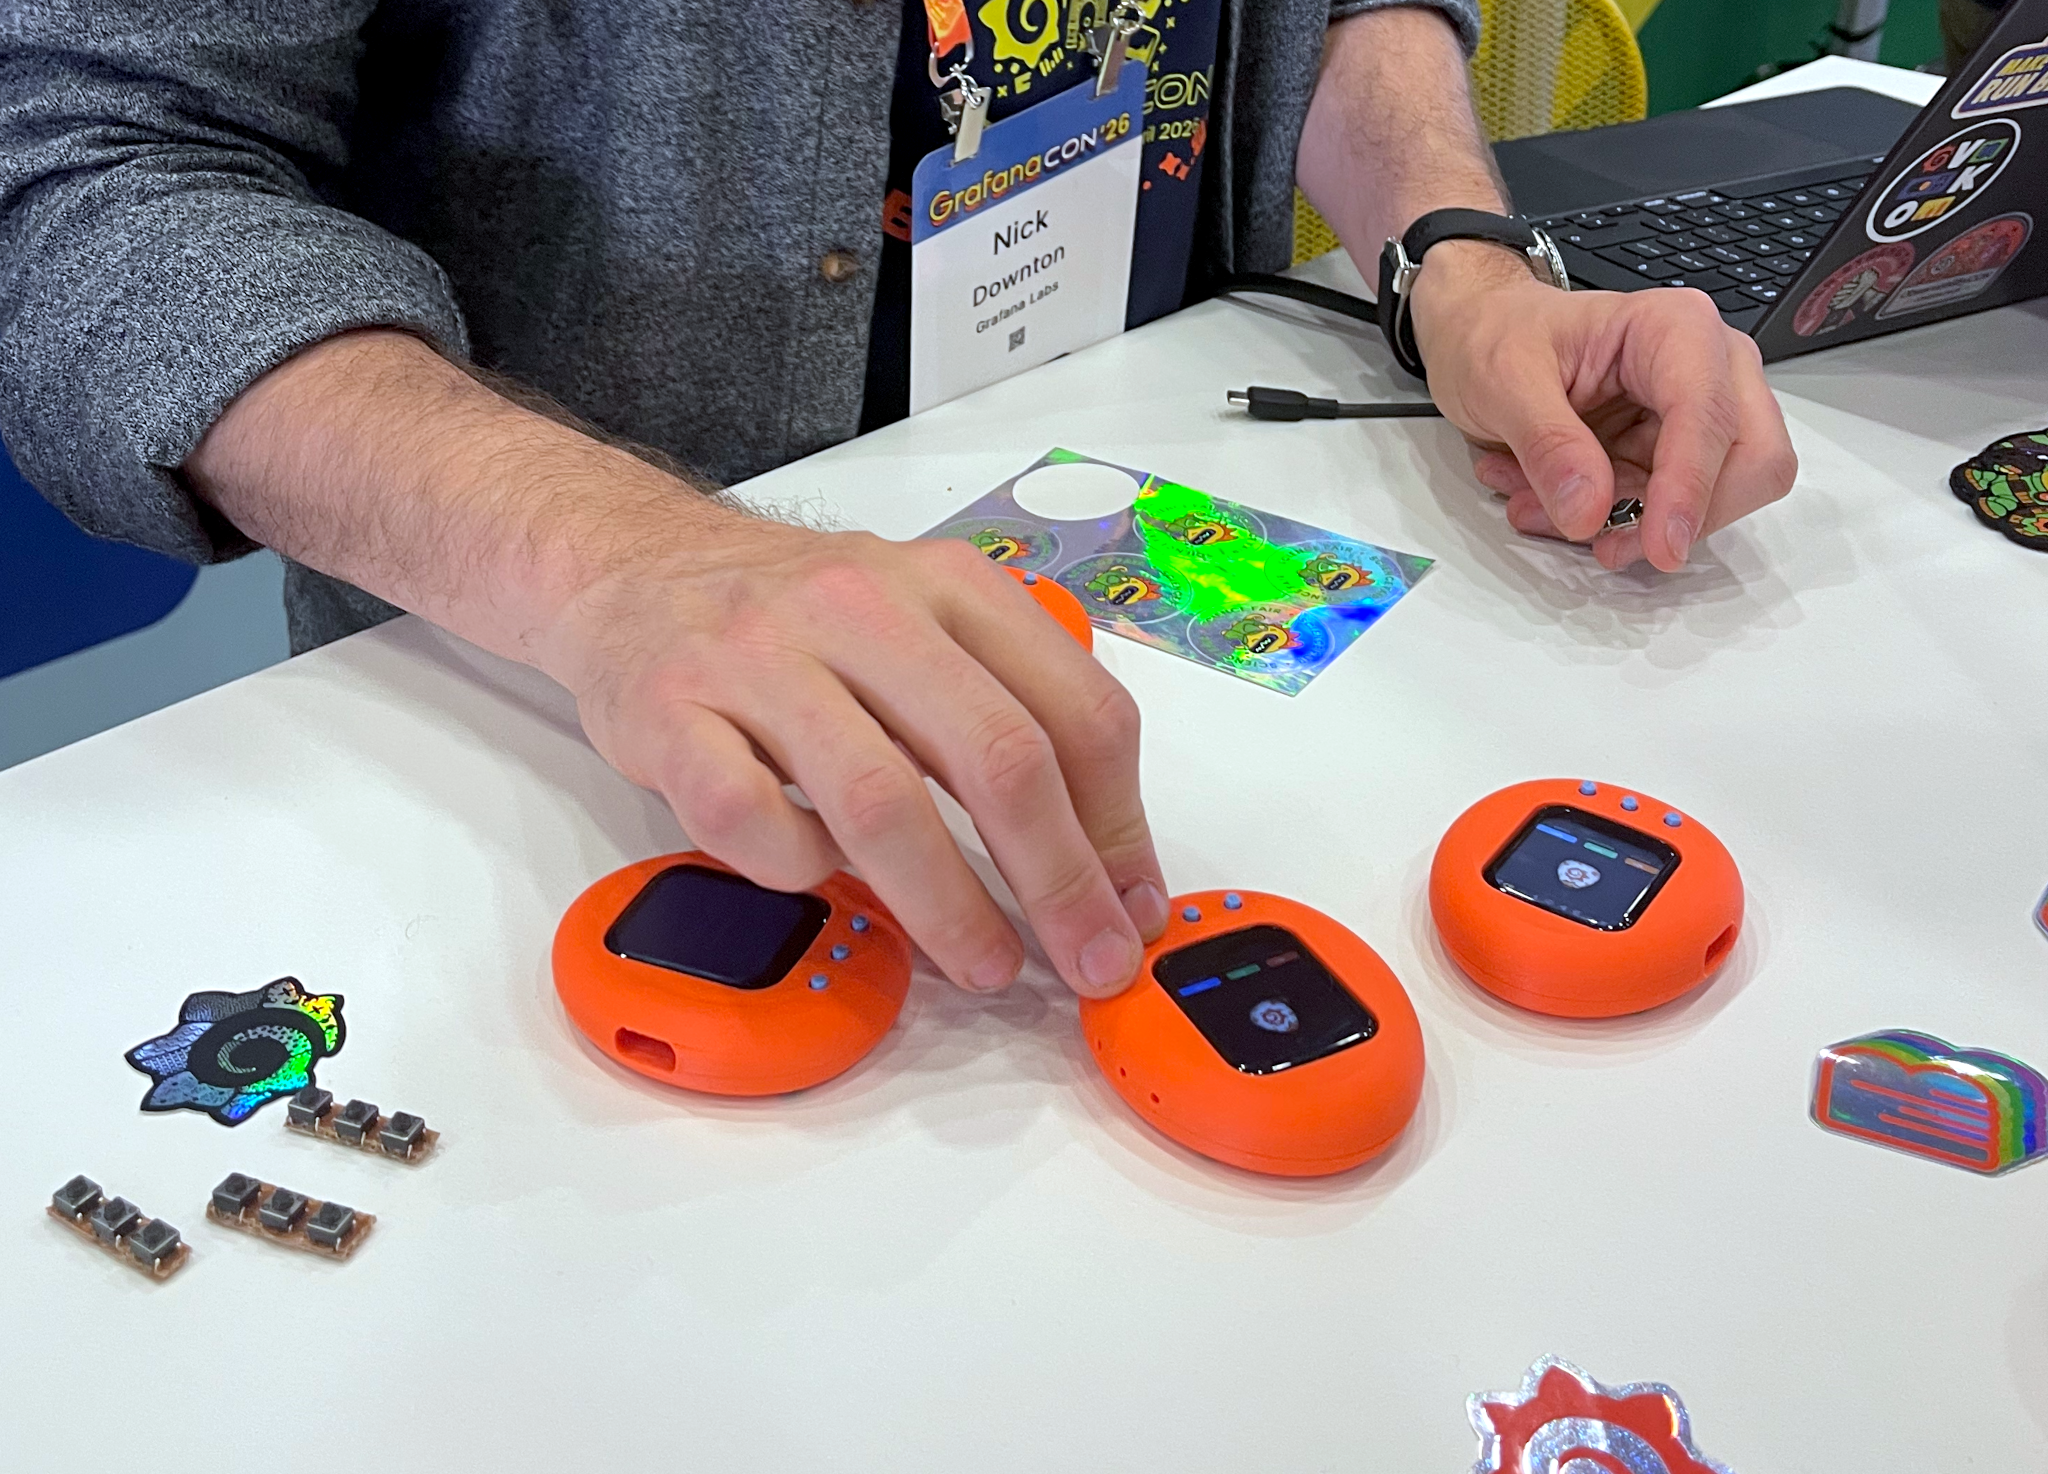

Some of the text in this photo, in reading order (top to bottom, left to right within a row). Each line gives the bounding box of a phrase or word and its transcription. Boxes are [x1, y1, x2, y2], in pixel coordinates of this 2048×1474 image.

[1971, 72, 2041, 104] RUN
[930, 128, 1098, 224] GrafanaCON
[994, 210, 1048, 255] Nick
[973, 246, 1064, 307] Downton
[976, 281, 1059, 333] Grafana Labs
[1251, 606, 1282, 614] FAIR
